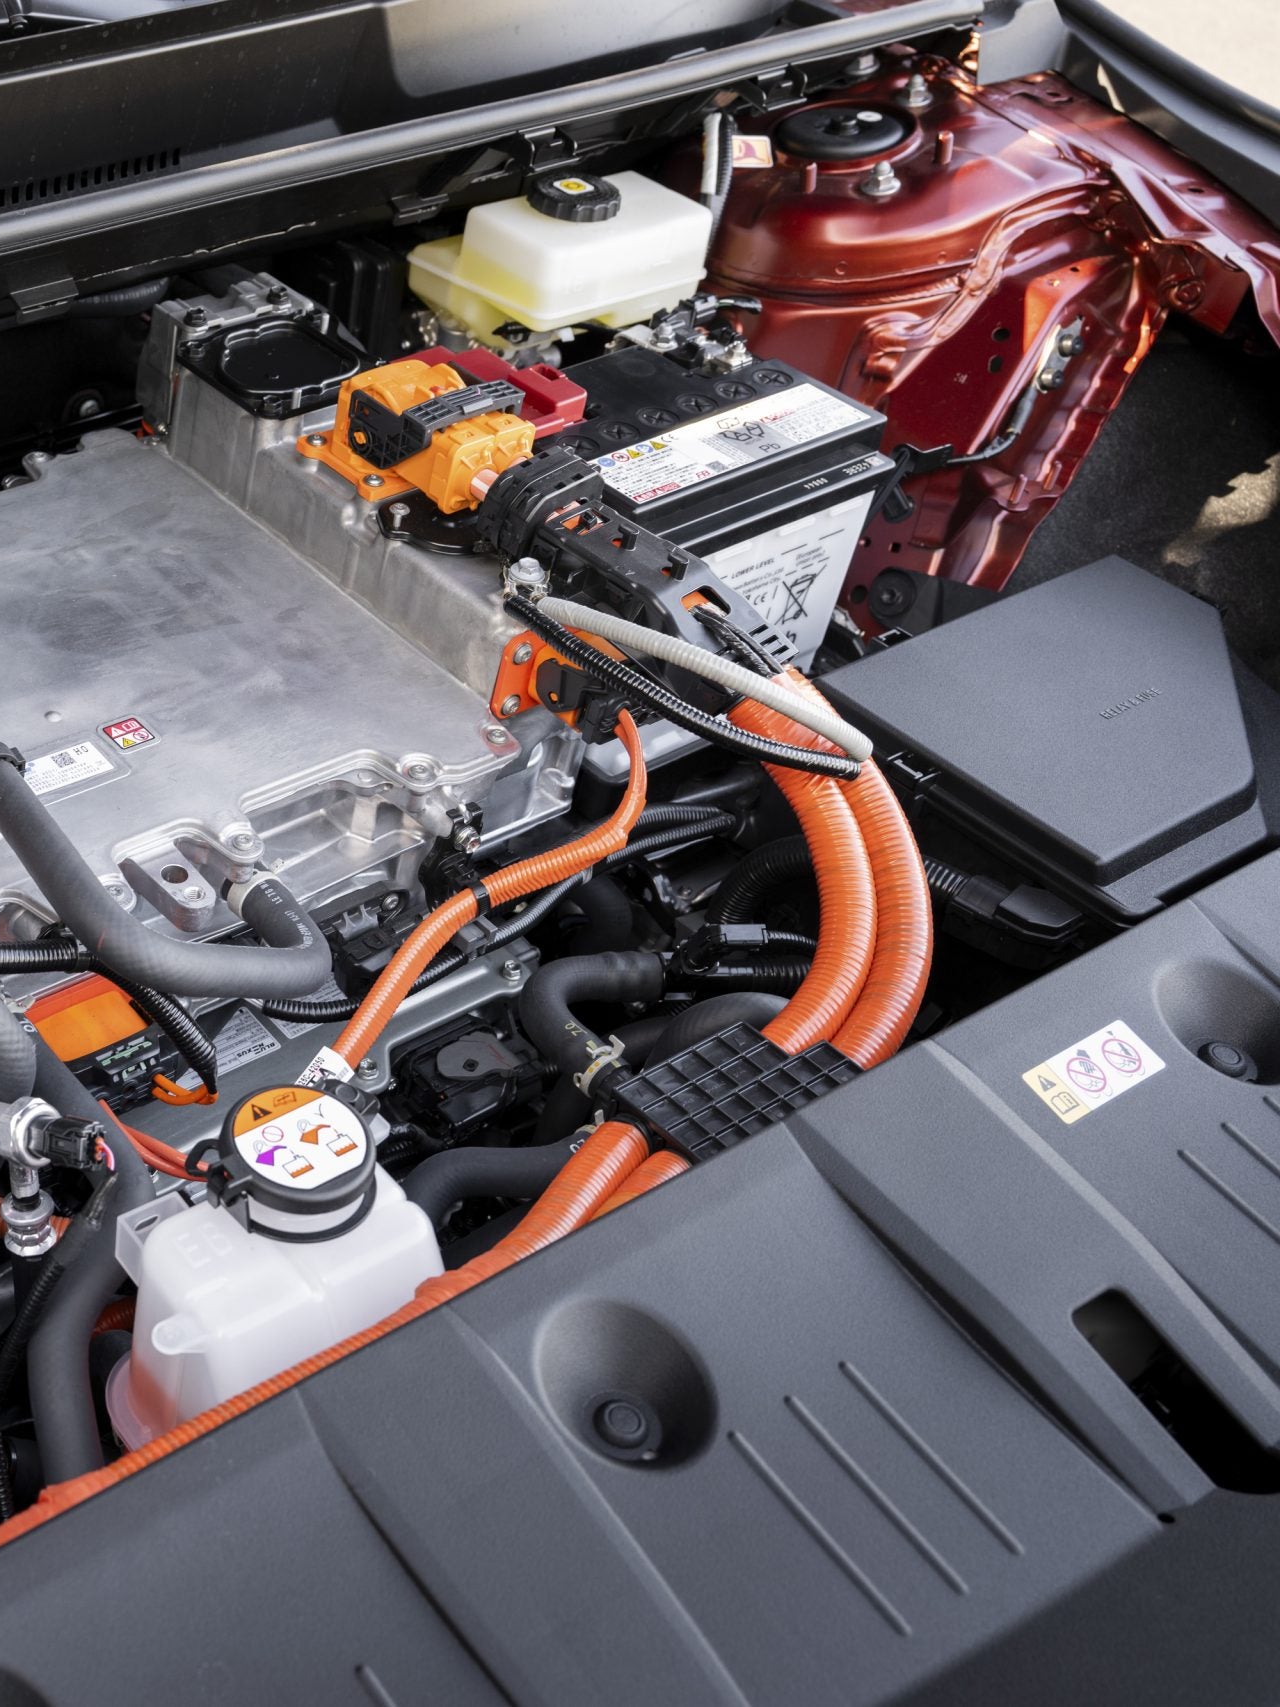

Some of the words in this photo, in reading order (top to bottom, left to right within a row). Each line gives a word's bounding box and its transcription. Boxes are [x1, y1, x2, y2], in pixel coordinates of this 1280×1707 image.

[759, 443, 781, 453] Pb
[731, 566, 754, 579] LOWER
[755, 558, 774, 570] LEVEL
[1099, 701, 1131, 720] RELAY
